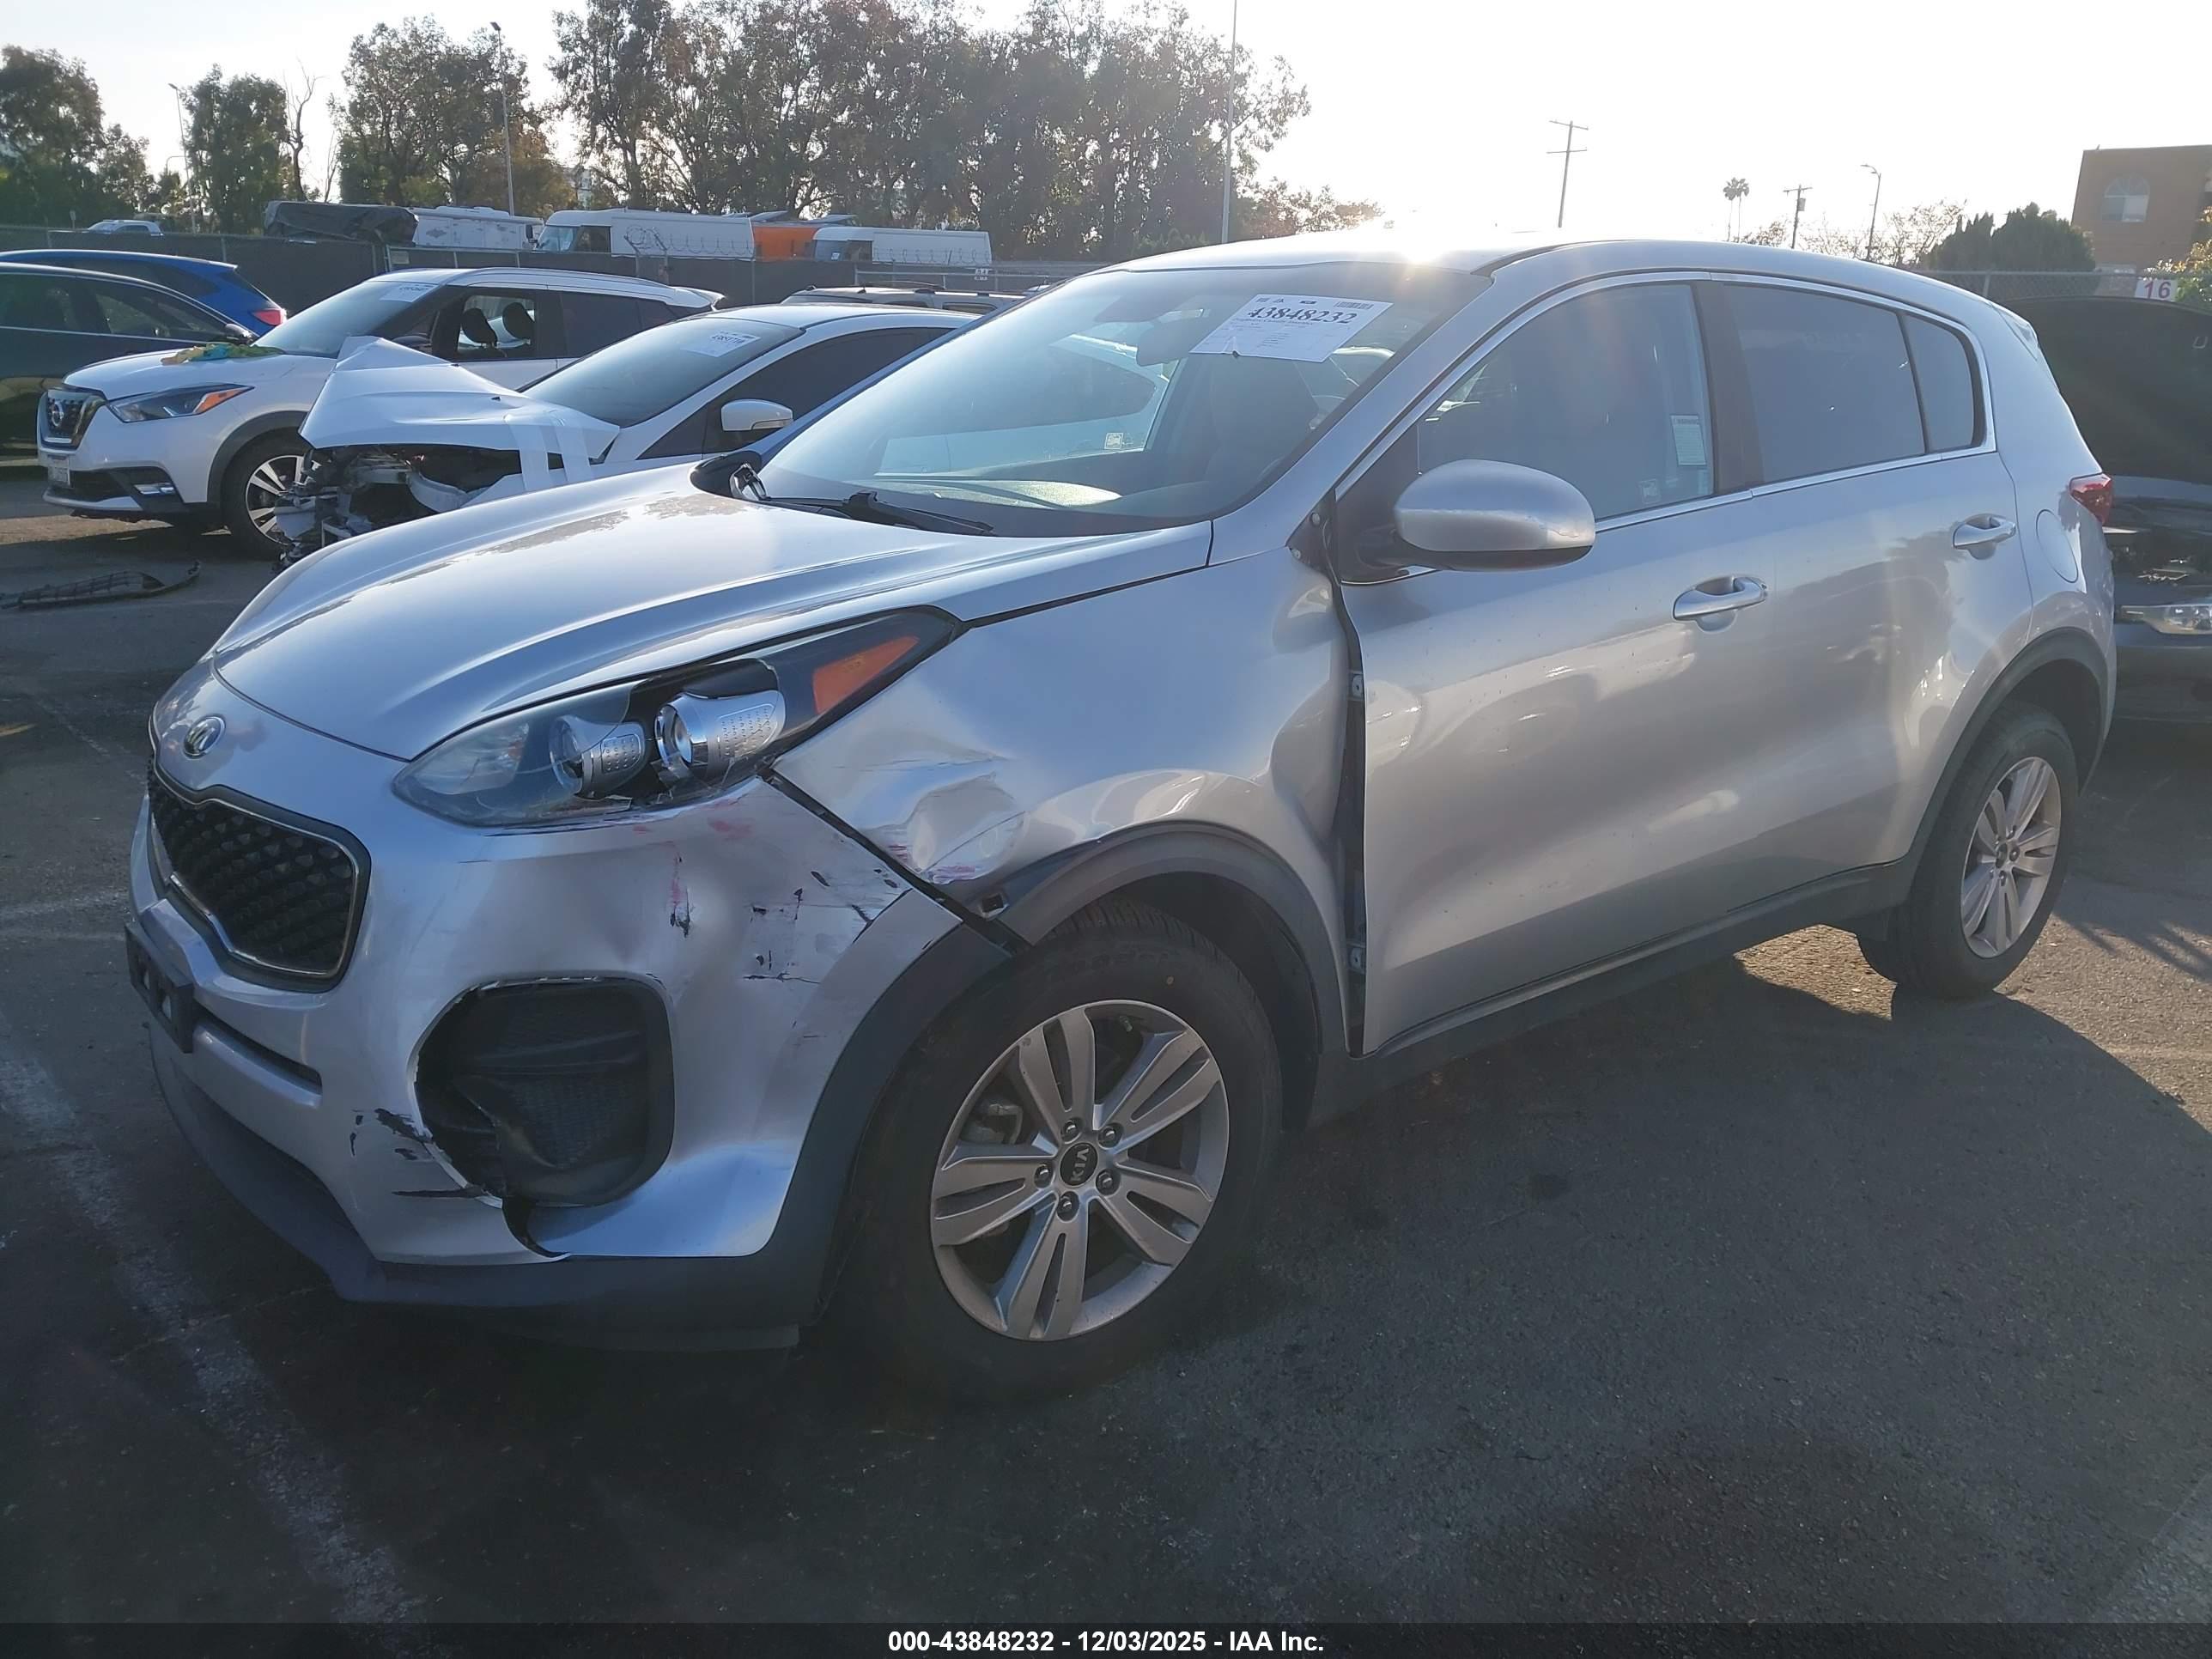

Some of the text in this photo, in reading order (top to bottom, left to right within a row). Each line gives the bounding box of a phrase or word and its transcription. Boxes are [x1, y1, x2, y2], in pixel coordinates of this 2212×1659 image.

[2144, 281, 2172, 299] 16
[1249, 307, 1357, 324] 43848232
[1070, 1148, 1089, 1181] KIA
